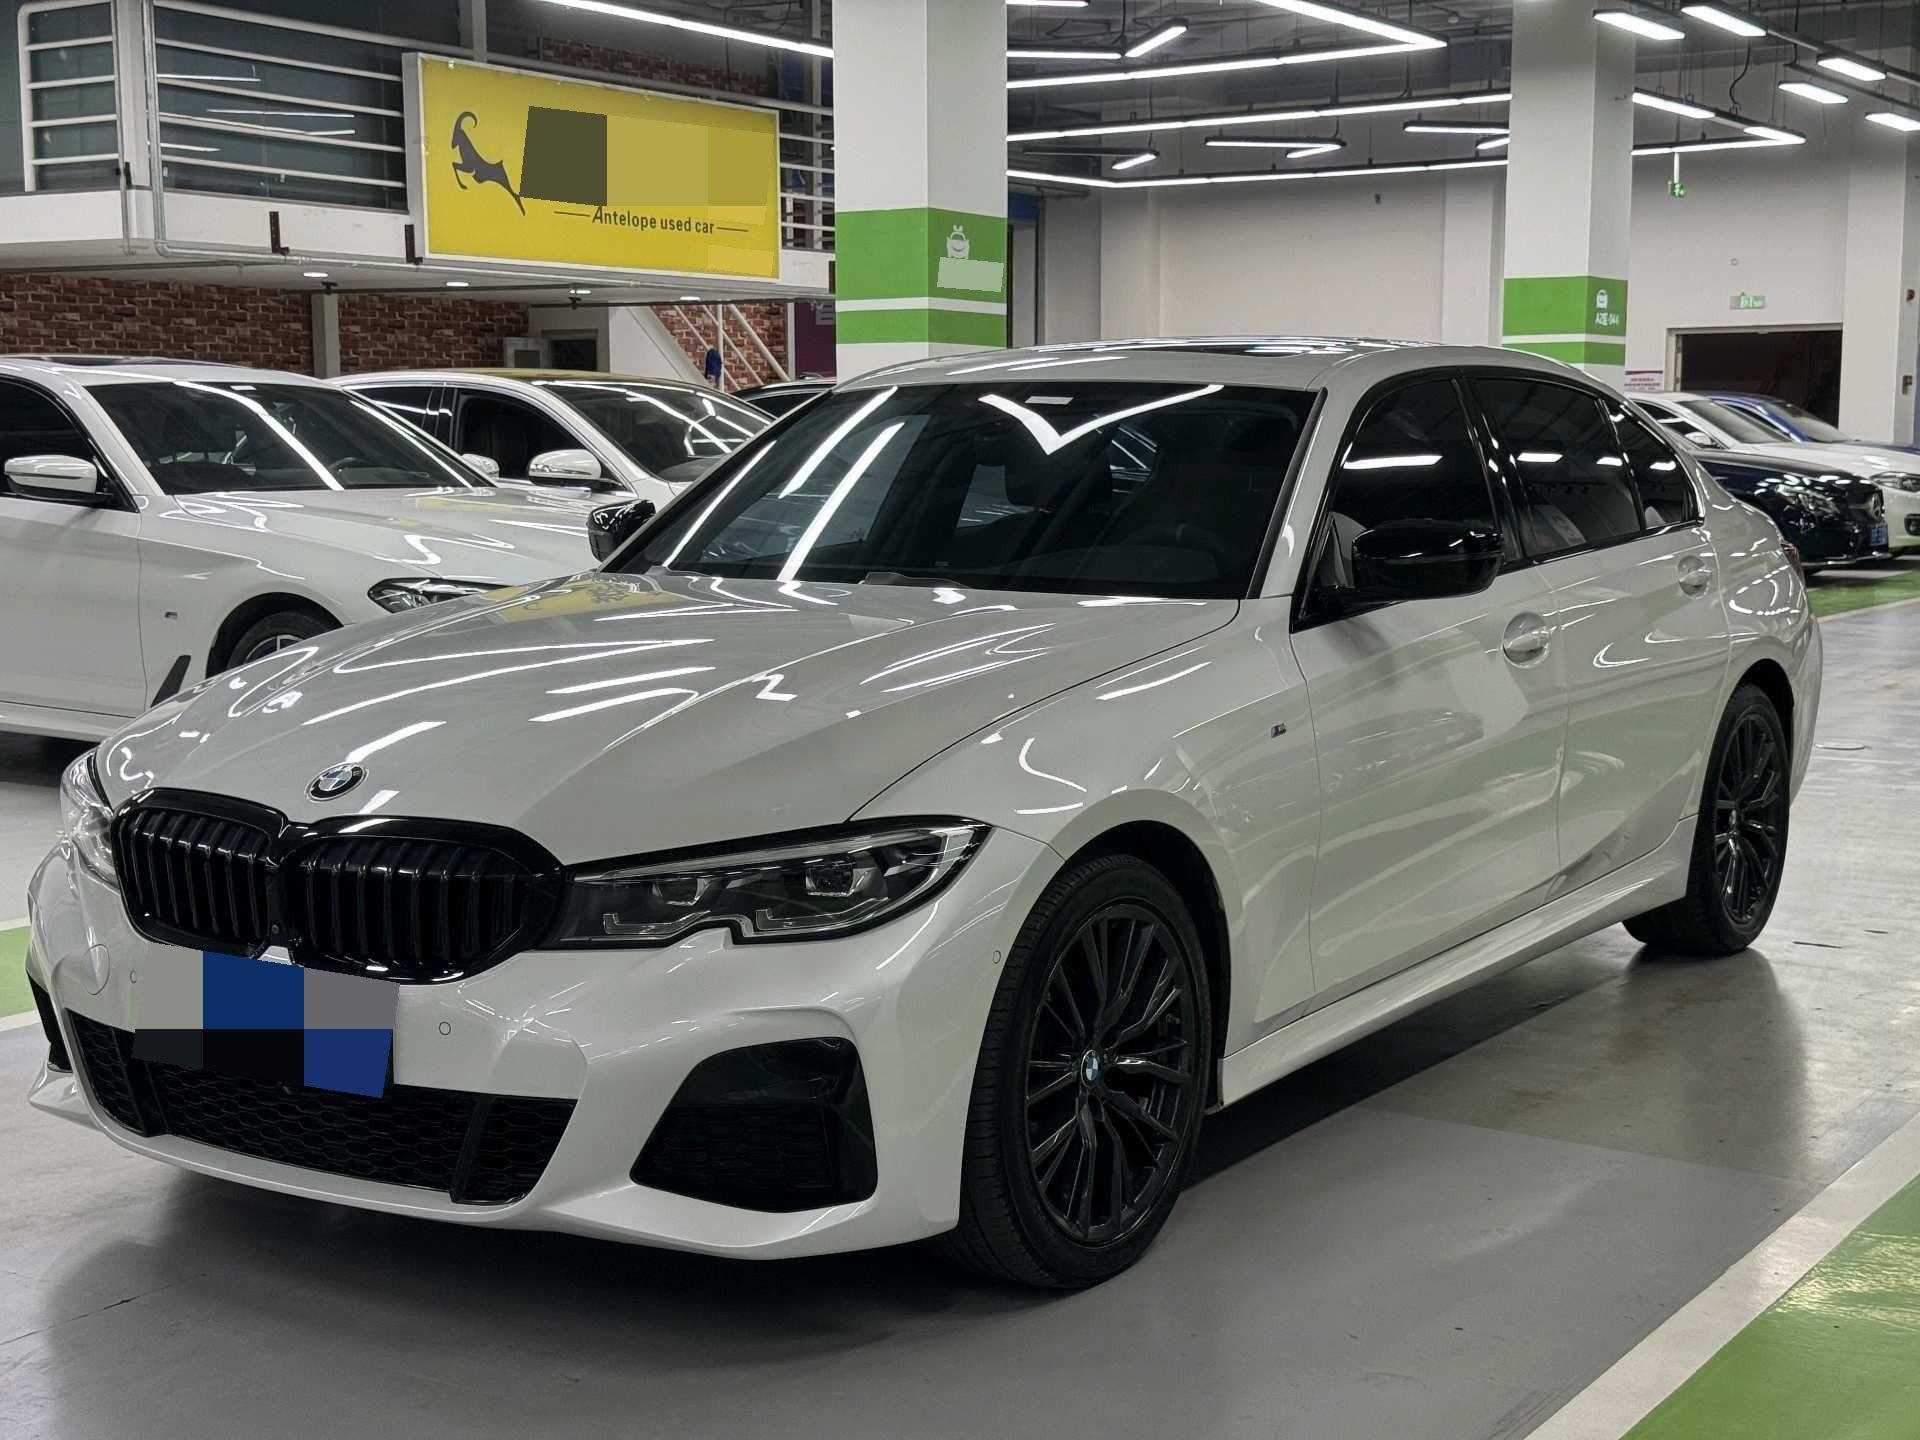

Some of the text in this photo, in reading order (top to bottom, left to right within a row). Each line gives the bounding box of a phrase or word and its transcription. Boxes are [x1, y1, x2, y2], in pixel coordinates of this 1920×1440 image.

[592, 206, 715, 235] Antelope used car
